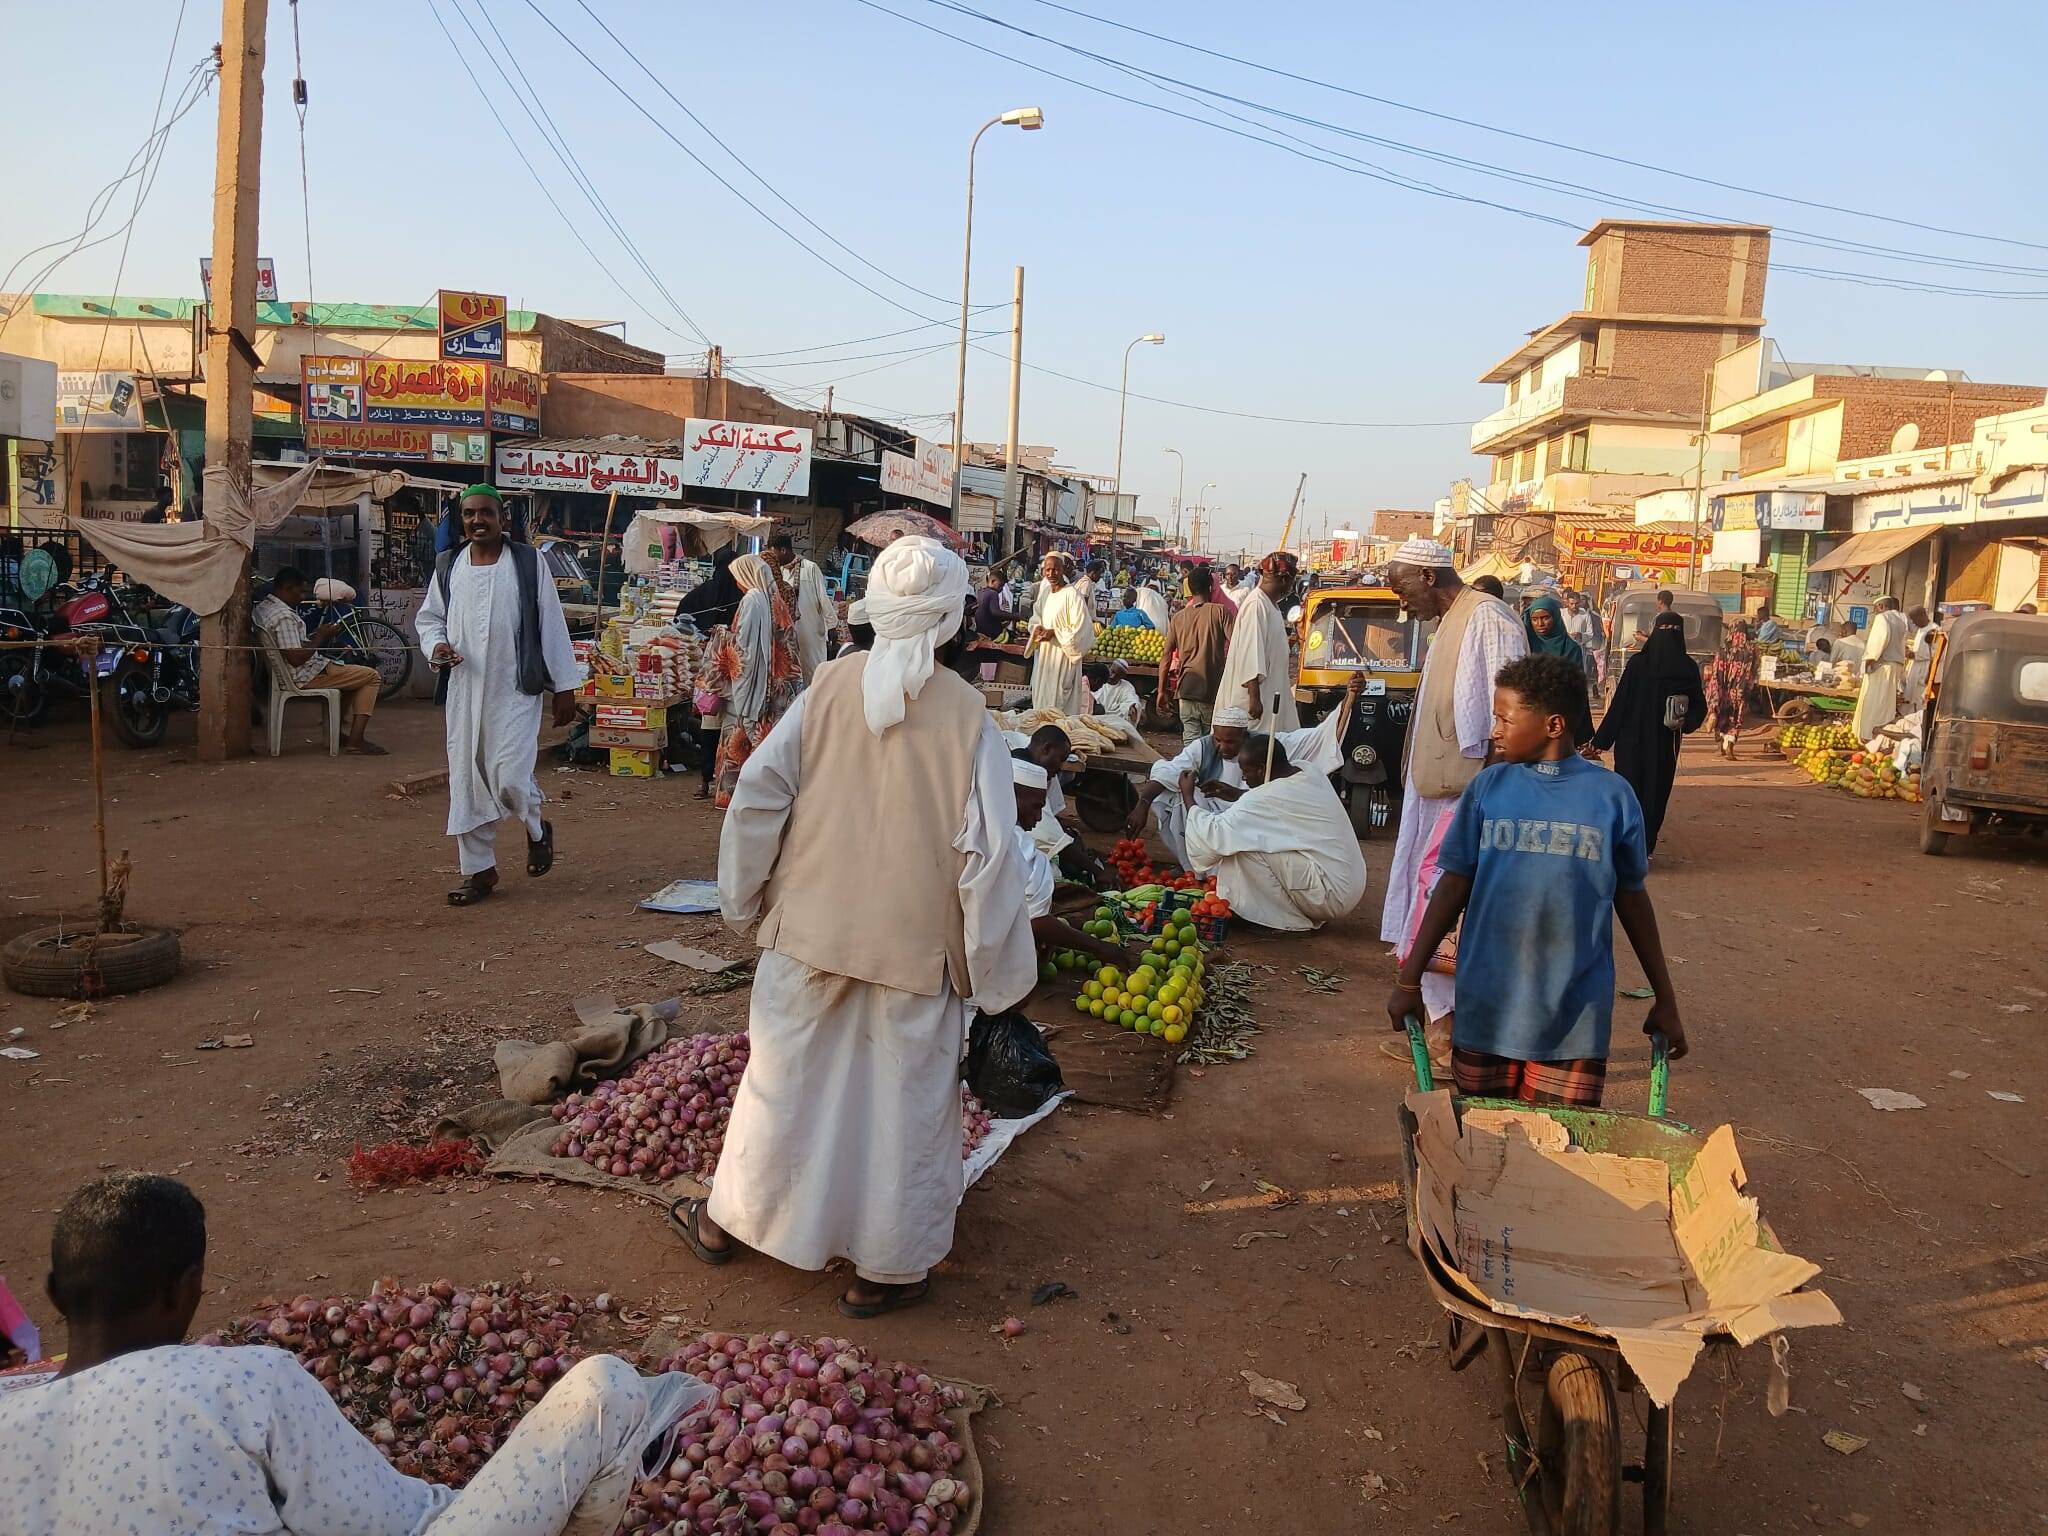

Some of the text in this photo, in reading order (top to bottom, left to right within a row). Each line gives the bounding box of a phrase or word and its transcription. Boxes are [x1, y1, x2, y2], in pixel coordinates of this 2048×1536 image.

[447, 367, 484, 402] درة
[690, 423, 801, 455] مكتبة الفكر
[500, 452, 589, 480] للخدمات
[590, 457, 659, 491] الشيخ
[1576, 533, 1639, 554] الجيد
[1480, 818, 1604, 861] JOKER
